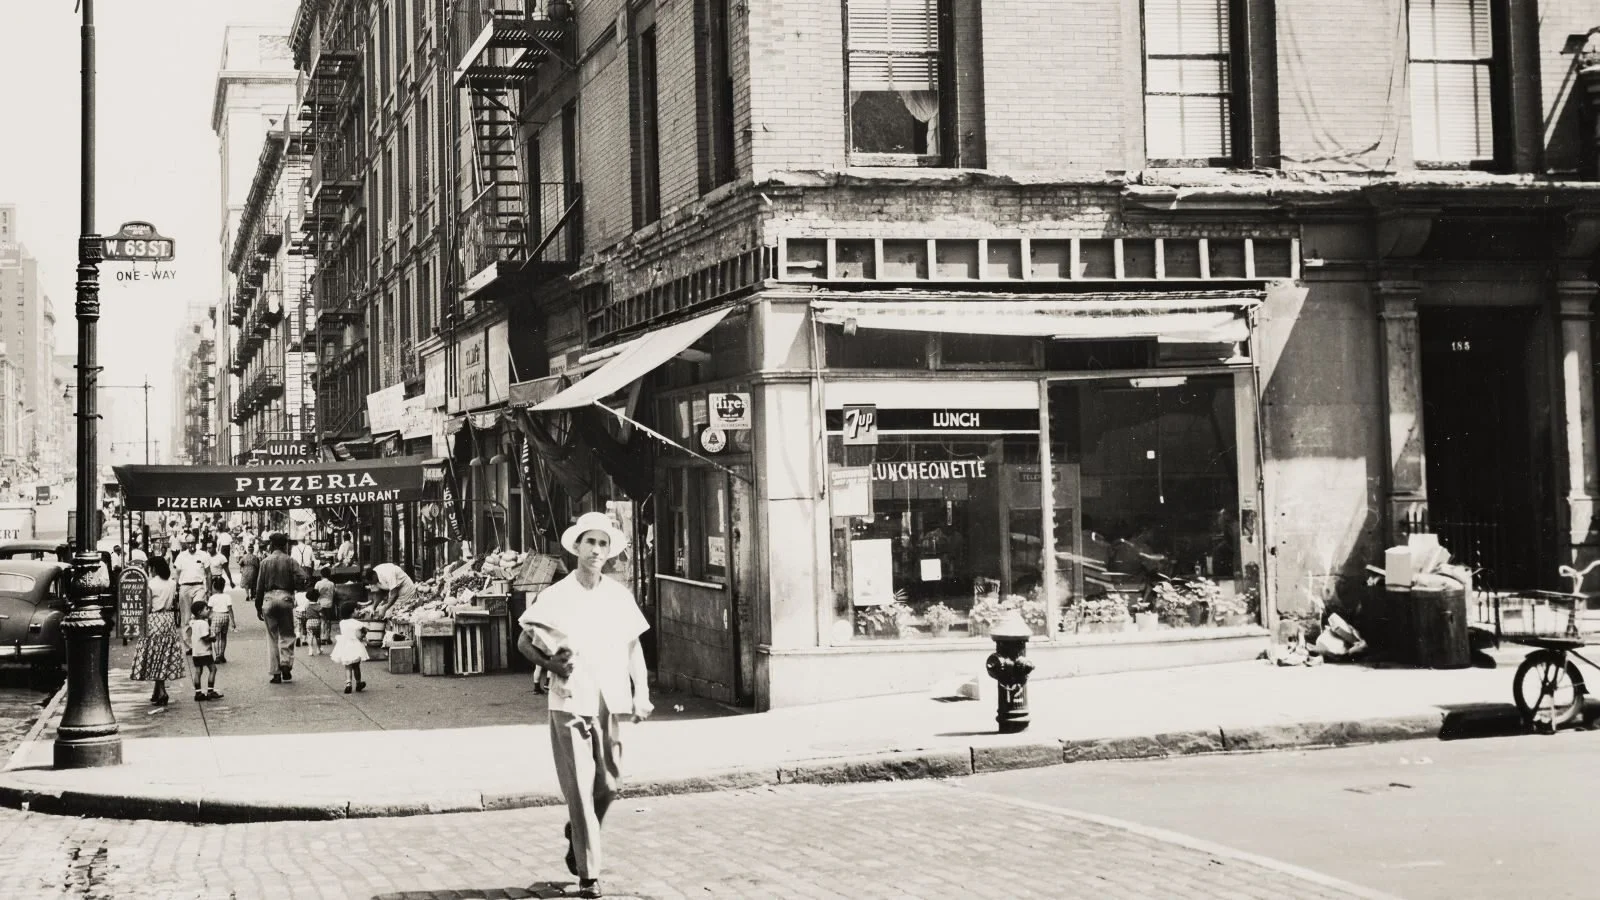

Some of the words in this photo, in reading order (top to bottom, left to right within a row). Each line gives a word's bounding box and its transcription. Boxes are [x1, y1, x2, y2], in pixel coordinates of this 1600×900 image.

[105, 240, 120, 256] W.
[125, 240, 146, 256] 63
[932, 412, 980, 427] LUNCH
[269, 444, 307, 456] WINE
[869, 460, 987, 481] LUNCHEONETTE
[235, 472, 378, 492] PIZZERIA
[157, 497, 223, 508] PIZZERIA
[316, 489, 400, 505] RESTAURANT
